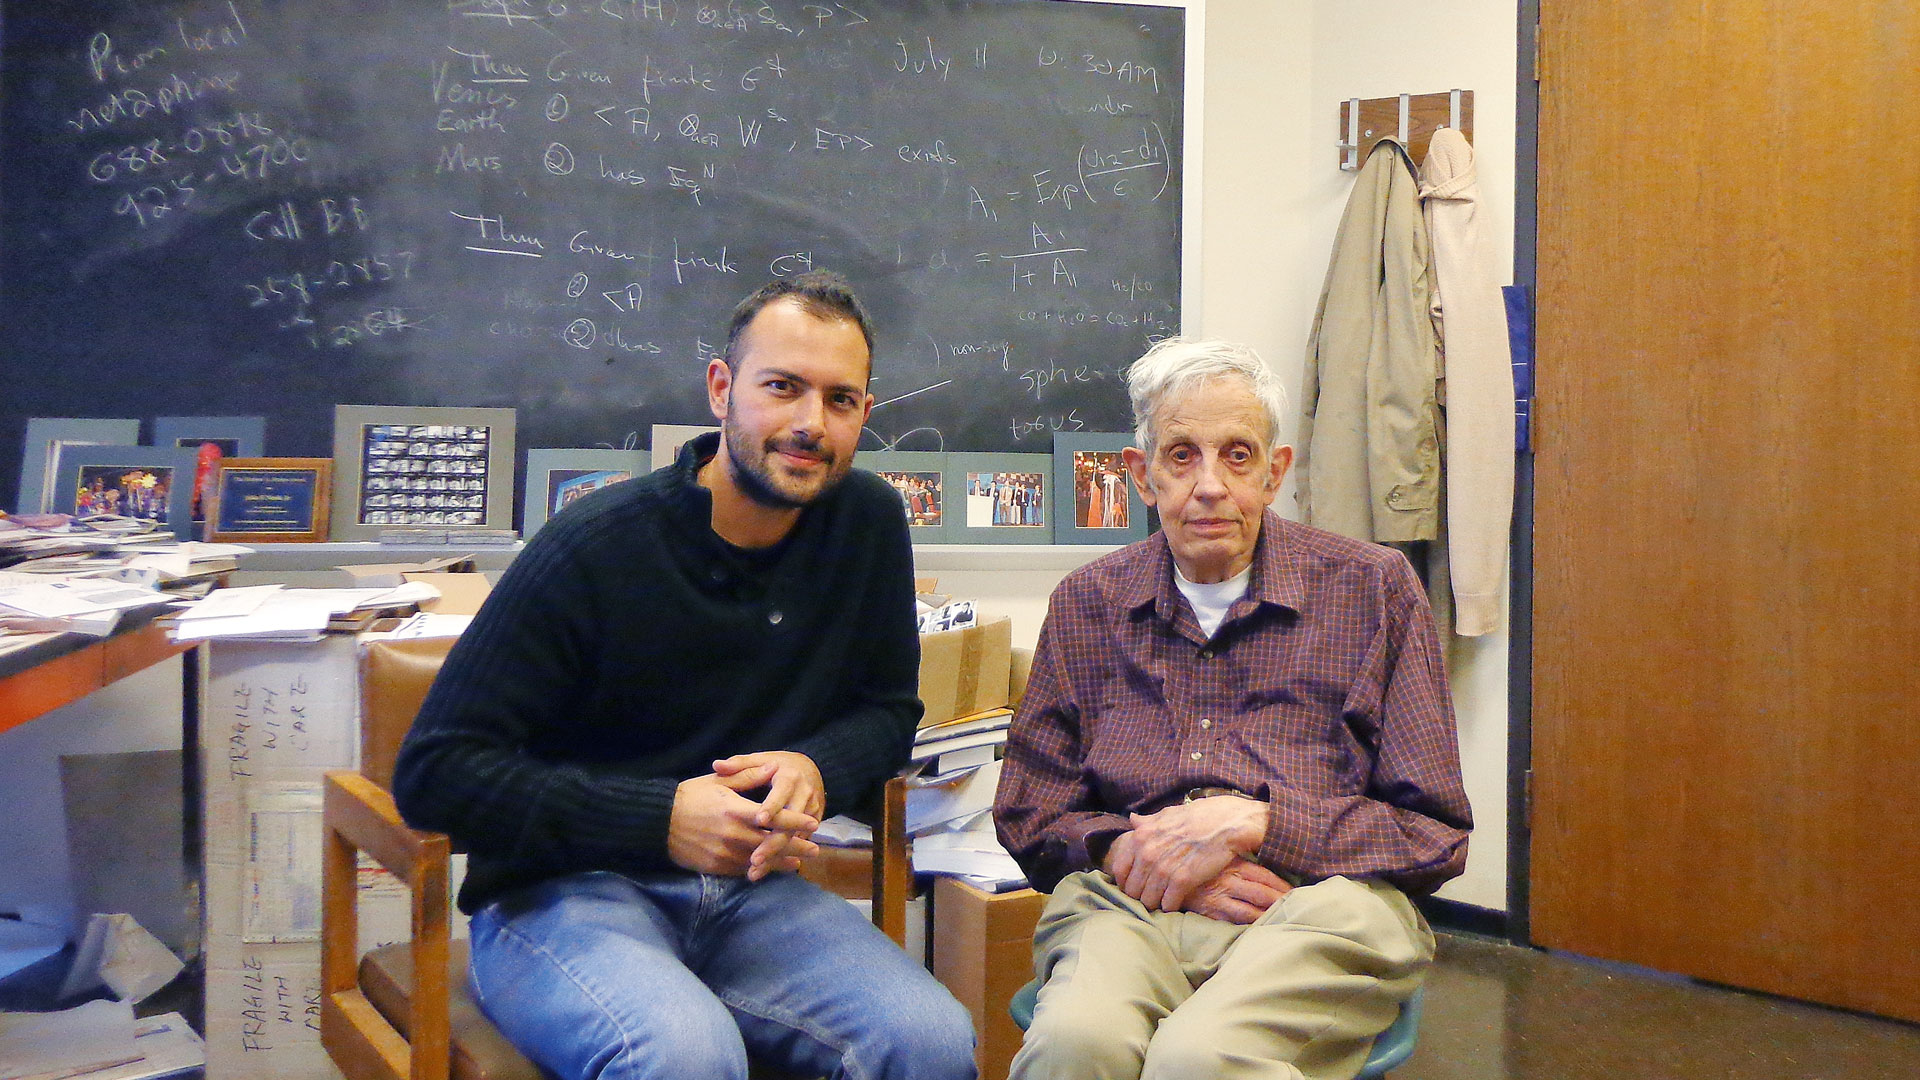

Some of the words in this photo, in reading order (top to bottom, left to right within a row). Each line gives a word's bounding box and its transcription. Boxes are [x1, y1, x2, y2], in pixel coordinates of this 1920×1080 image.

[894, 36, 950, 81] July
[432, 60, 517, 110] Venus
[437, 108, 506, 134] Earth
[436, 143, 502, 174] Mars
[228, 682, 253, 780] FRAGILE
[262, 686, 280, 751] WITH
[290, 673, 309, 752] CARE
[242, 956, 273, 1053] FRAGILE
[278, 976, 293, 1024] WITH
[303, 984, 322, 1033] CAR
